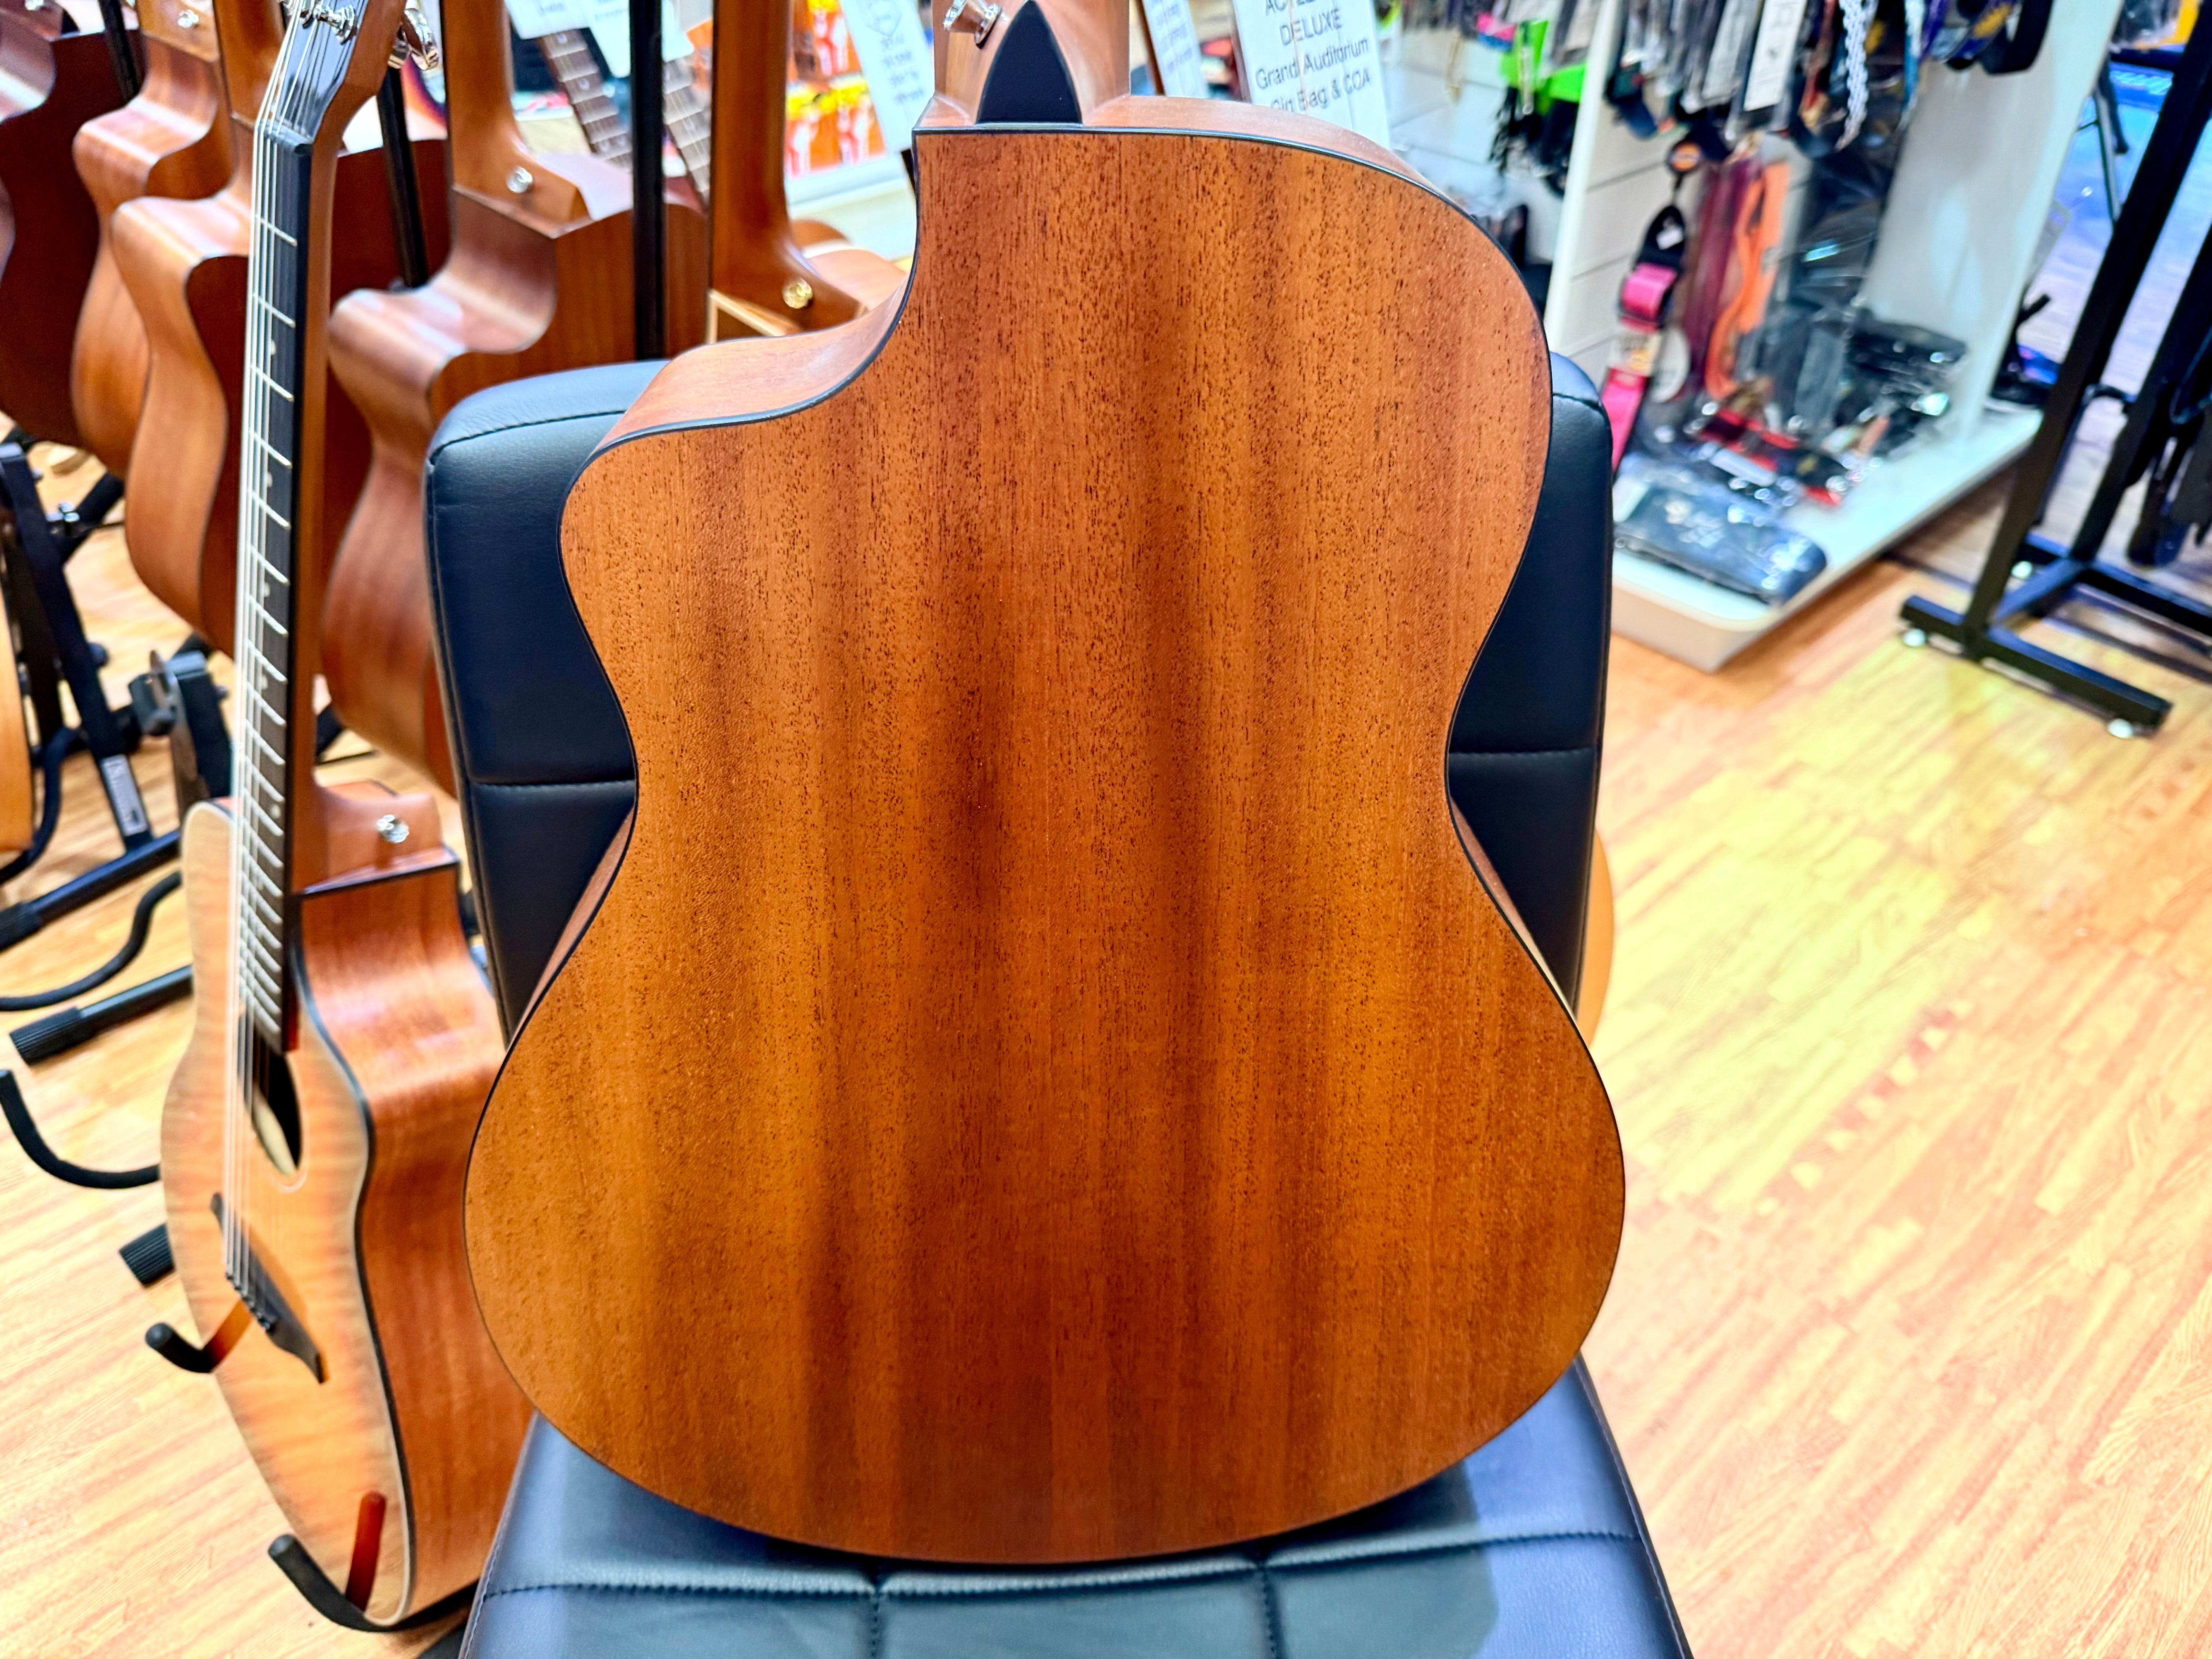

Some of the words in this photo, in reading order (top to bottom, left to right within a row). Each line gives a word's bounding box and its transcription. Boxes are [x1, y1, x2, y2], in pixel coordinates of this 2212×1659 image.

[1279, 8, 1342, 45] DELUXE
[1256, 58, 1300, 89] Grand
[1303, 38, 1369, 74] Auditorium
[1297, 89, 1329, 112] Bag
